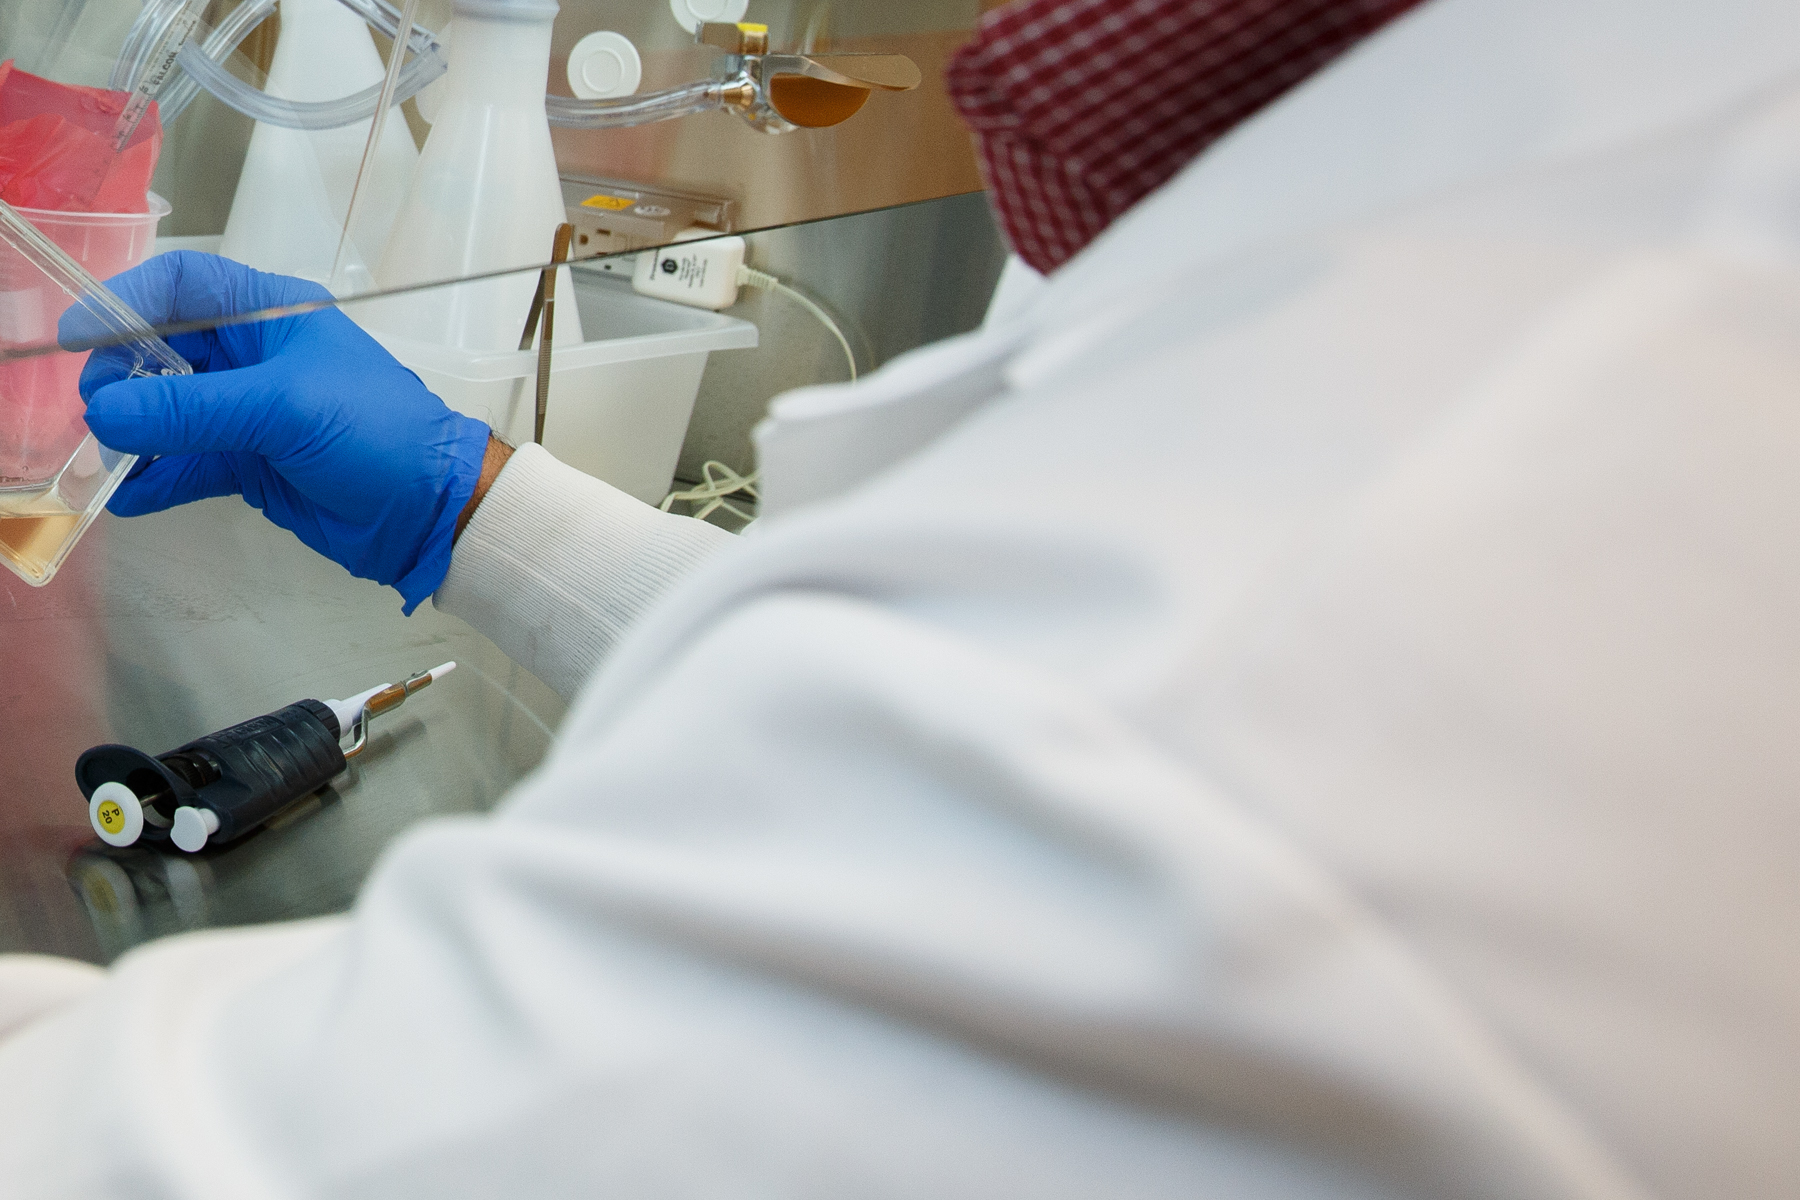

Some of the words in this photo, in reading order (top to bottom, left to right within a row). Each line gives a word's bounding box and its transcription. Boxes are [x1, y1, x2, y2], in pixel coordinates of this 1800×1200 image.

[153, 51, 178, 87] FALCON
[102, 810, 113, 824] 20
[111, 807, 120, 817] P
